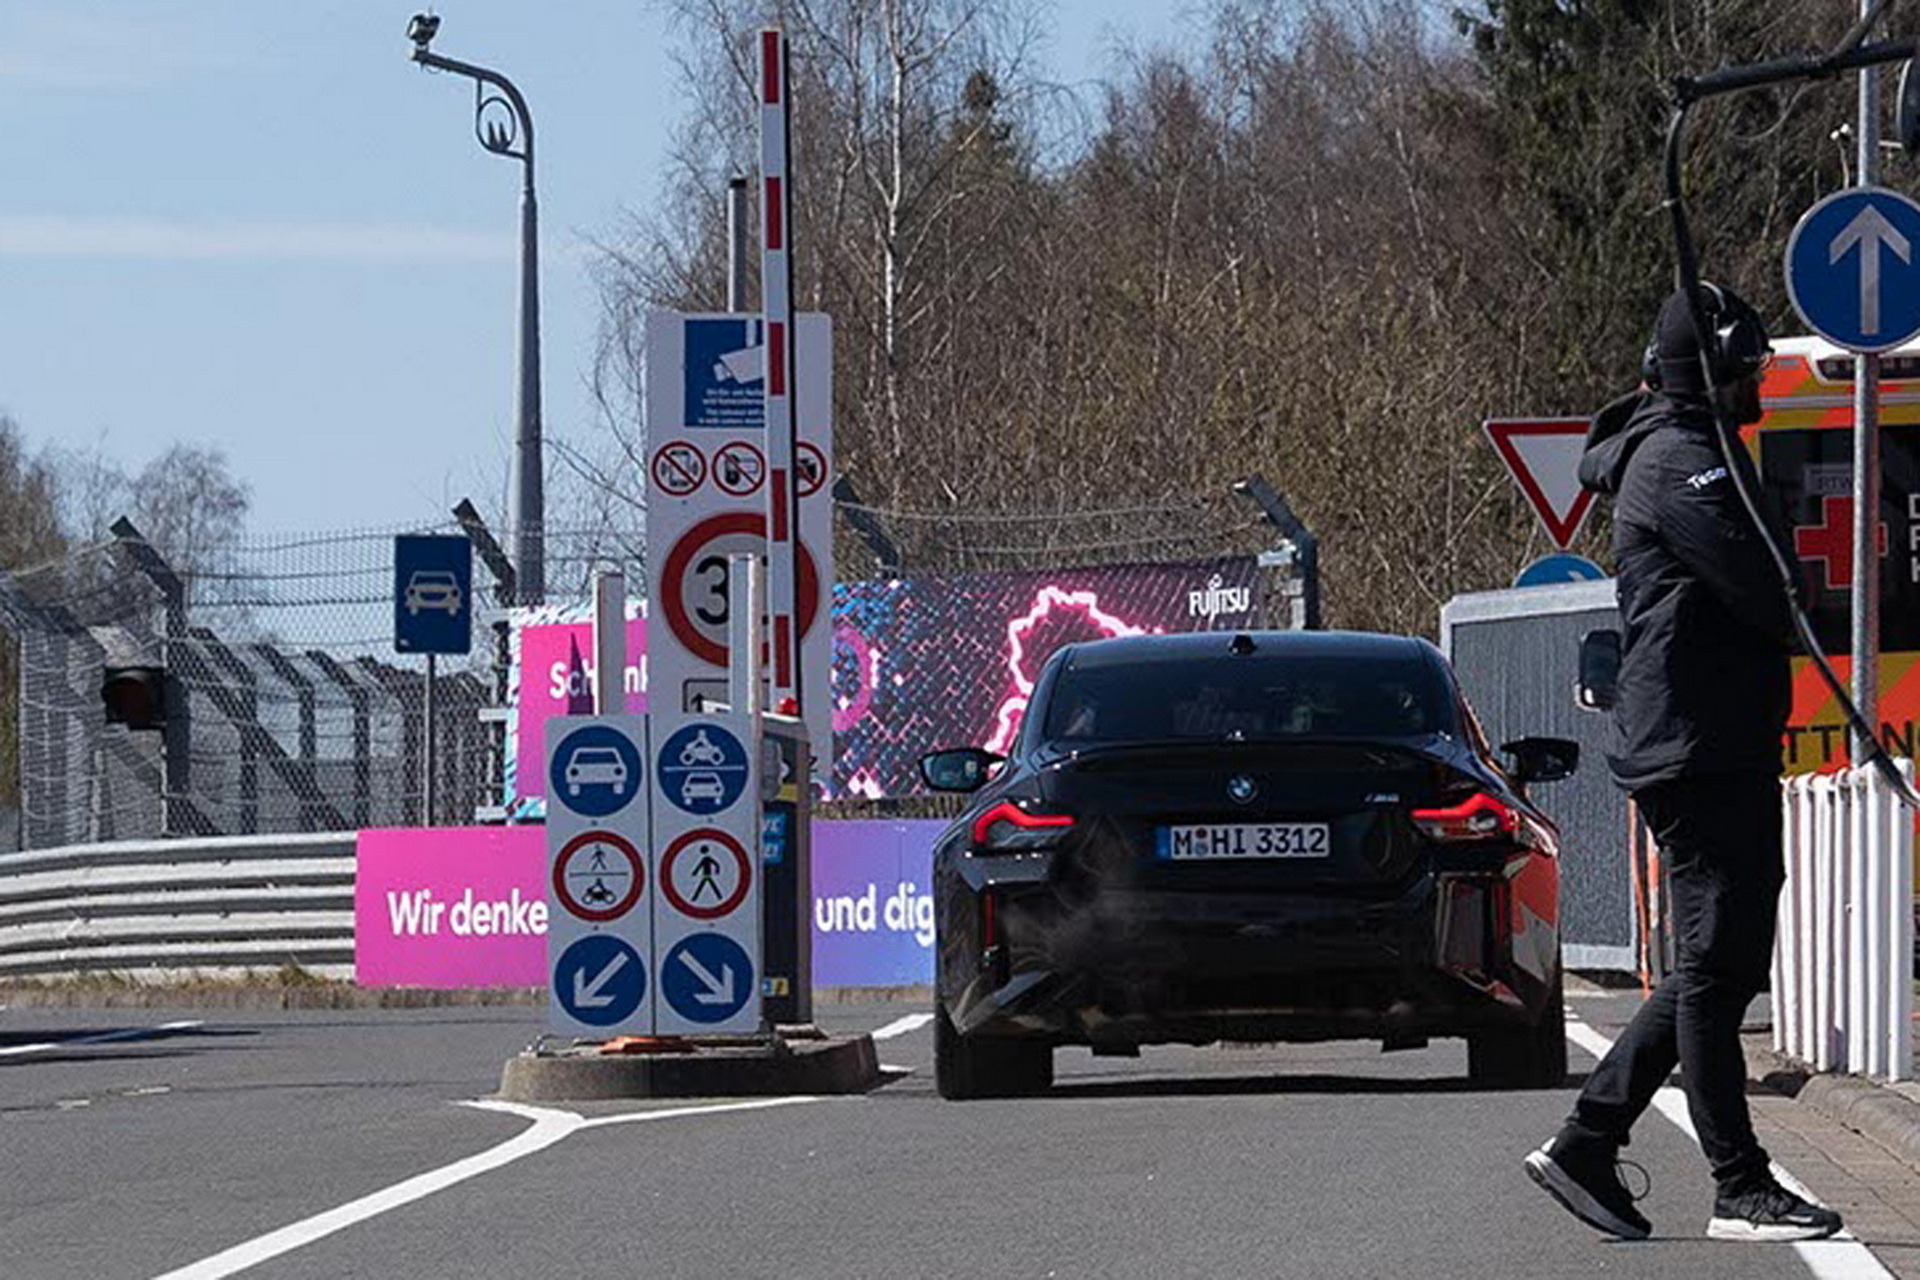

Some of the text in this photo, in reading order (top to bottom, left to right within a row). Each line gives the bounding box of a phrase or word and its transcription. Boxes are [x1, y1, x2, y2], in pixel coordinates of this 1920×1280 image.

[1189, 574, 1249, 622] FUJITSU
[1256, 827, 1326, 854] 3312
[387, 888, 549, 935] Wir denke
[816, 882, 936, 947] und dig
